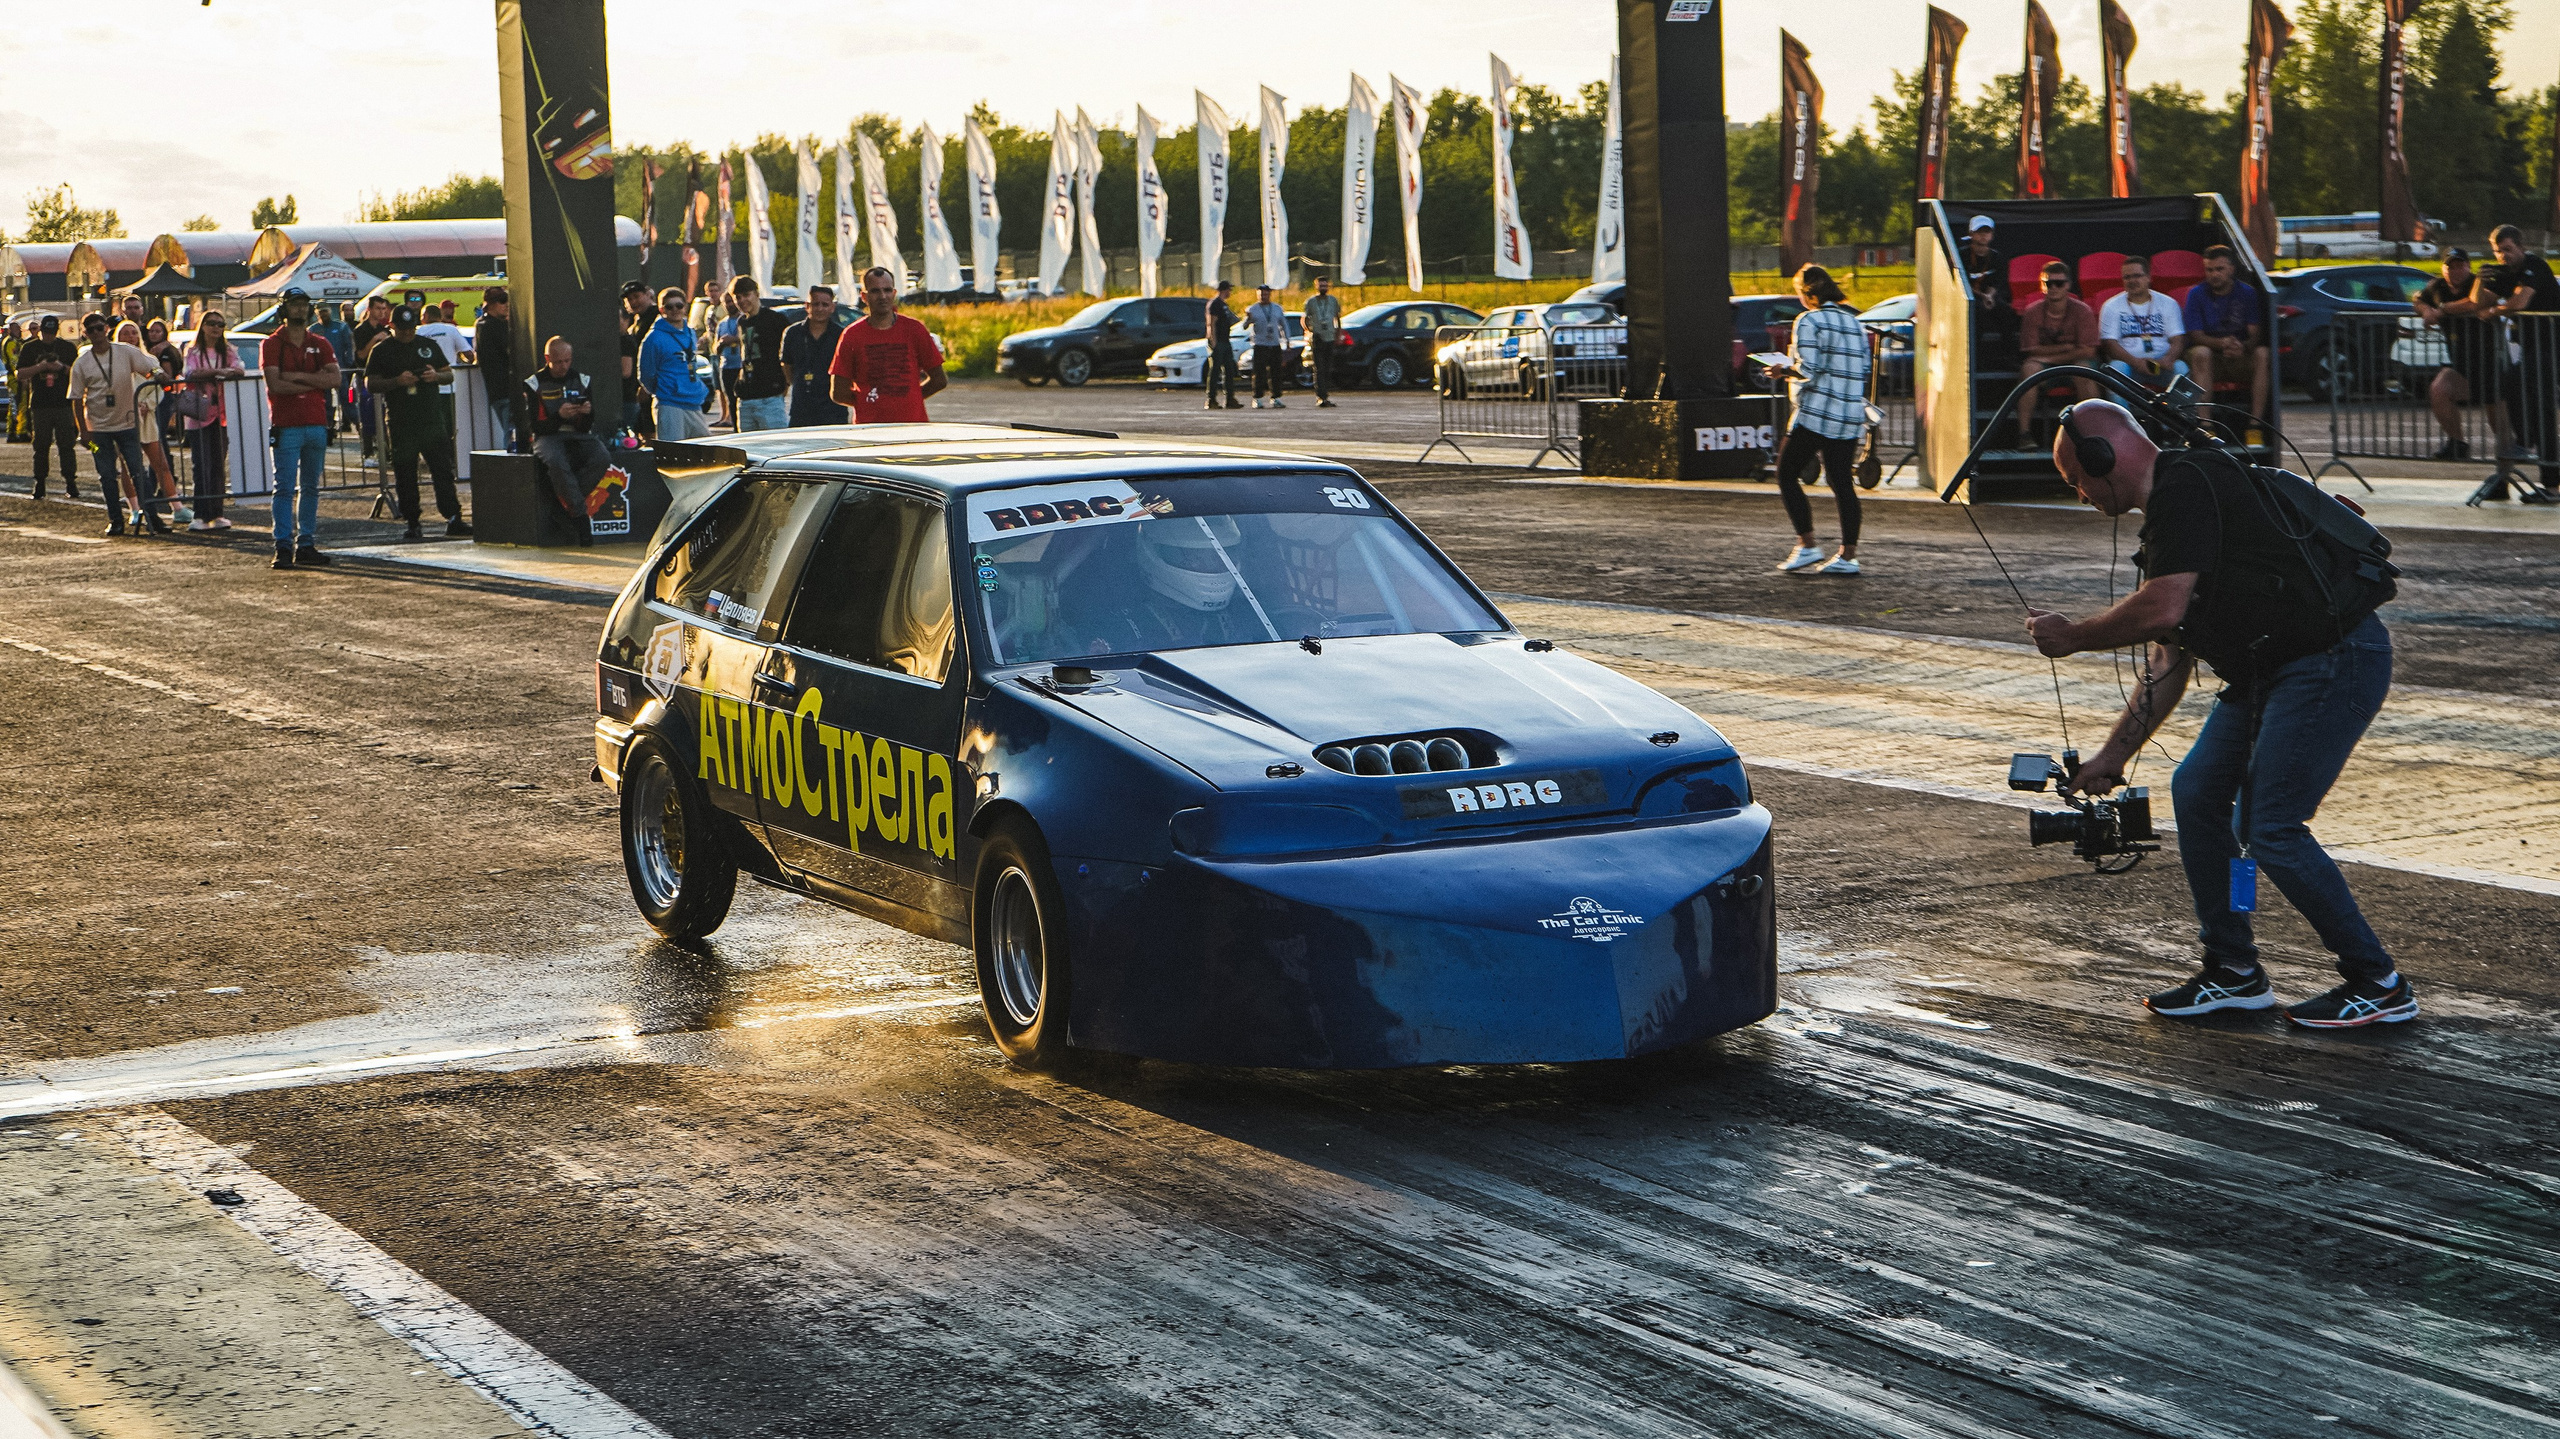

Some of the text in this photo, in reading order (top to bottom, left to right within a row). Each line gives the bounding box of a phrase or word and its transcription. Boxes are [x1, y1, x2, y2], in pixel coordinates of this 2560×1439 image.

[1694, 424, 1774, 452] RDRC
[1322, 486, 1371, 510] 20
[593, 521, 628, 531] RDRC
[983, 495, 1126, 532] RDRC
[717, 594, 758, 624] Цепляев
[611, 684, 627, 708] ВТБ
[1446, 779, 1563, 813] RDRC
[1537, 914, 1645, 929] The Car Clinic
